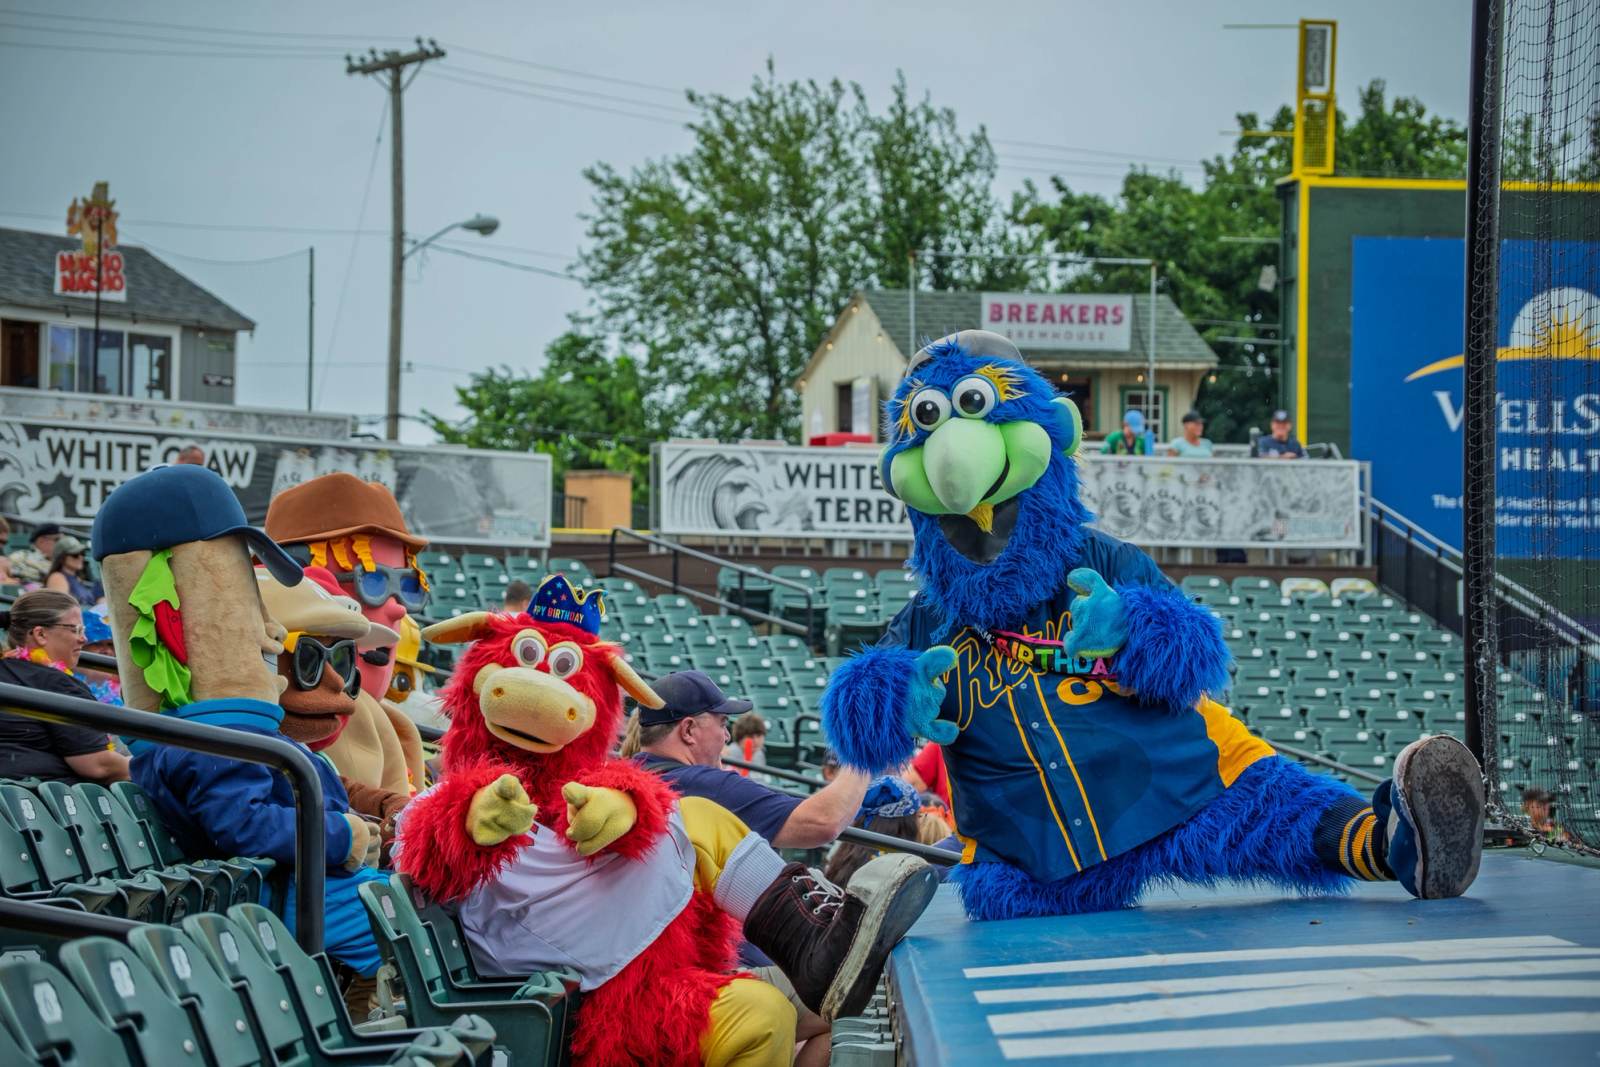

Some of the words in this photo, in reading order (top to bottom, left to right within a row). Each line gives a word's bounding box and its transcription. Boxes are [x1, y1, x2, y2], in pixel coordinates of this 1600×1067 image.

[61, 274, 124, 292] NACHO
[989, 303, 1124, 325] BREAKERS
[47, 436, 152, 472] WHITE
[162, 446, 250, 480] CAW
[784, 461, 884, 491] WHITE
[533, 604, 547, 617] PPY
[547, 607, 585, 624] BIRTHDAY
[996, 637, 1109, 676] BIRTHDA
